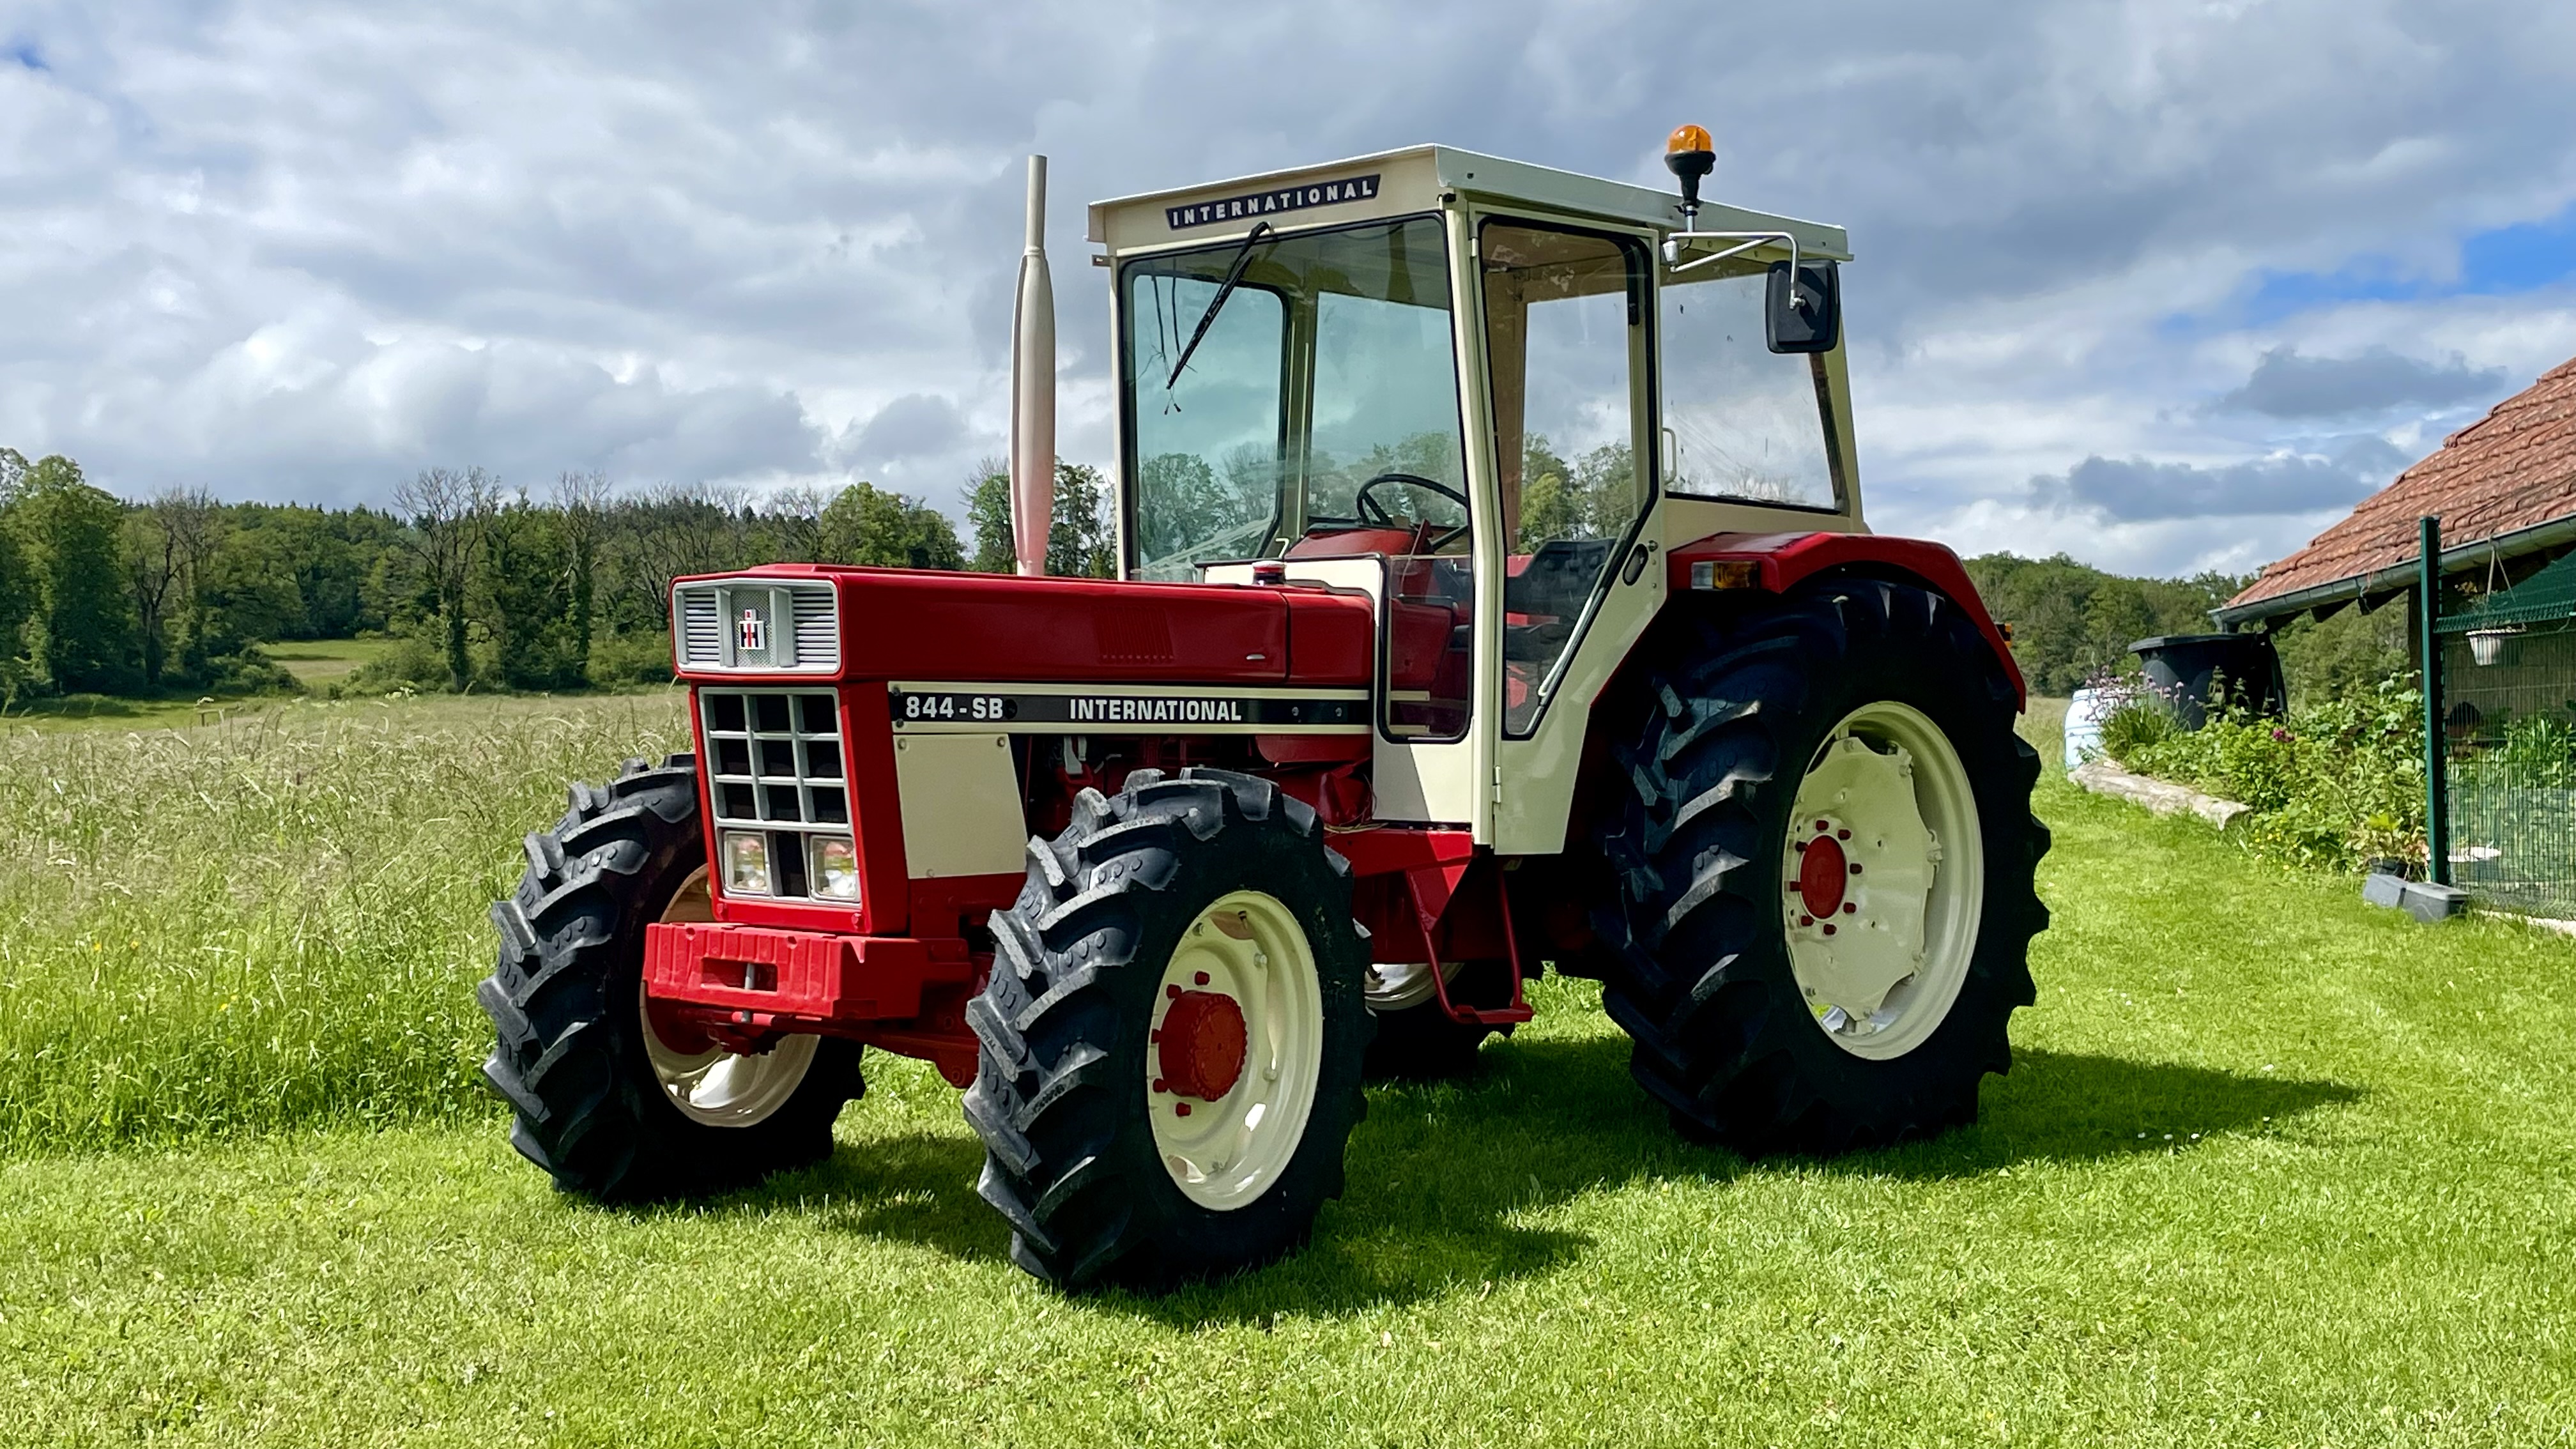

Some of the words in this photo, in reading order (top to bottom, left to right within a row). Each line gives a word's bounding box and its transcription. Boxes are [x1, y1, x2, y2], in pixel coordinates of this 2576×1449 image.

[1172, 180, 1372, 226] INTERNATIONAL
[906, 696, 1003, 719] 844-SB
[1070, 699, 1242, 721] INTERNATIONAL
